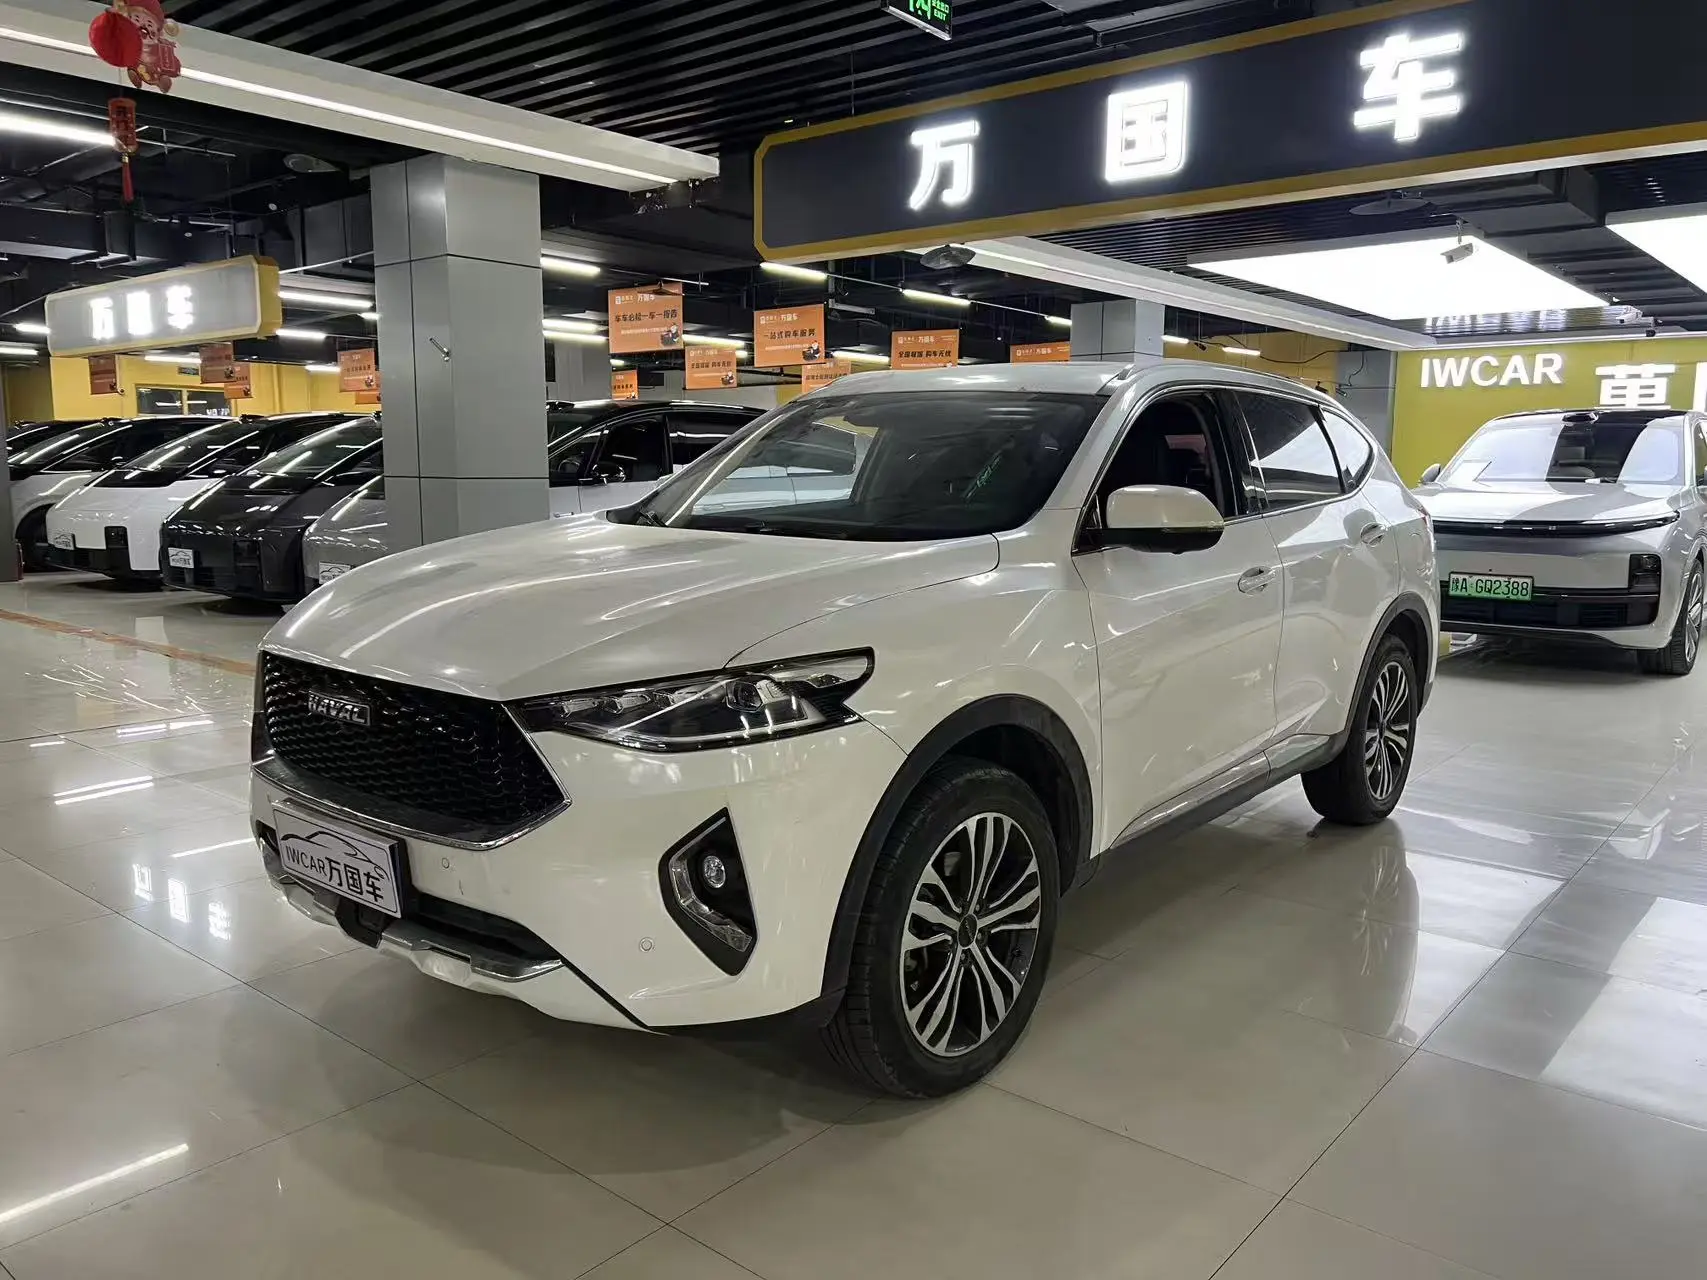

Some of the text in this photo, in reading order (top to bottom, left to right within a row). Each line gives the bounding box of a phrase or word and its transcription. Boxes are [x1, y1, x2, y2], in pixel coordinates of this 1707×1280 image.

[909, 31, 1464, 210] 万国车
[1420, 353, 1562, 388] IWCAR
